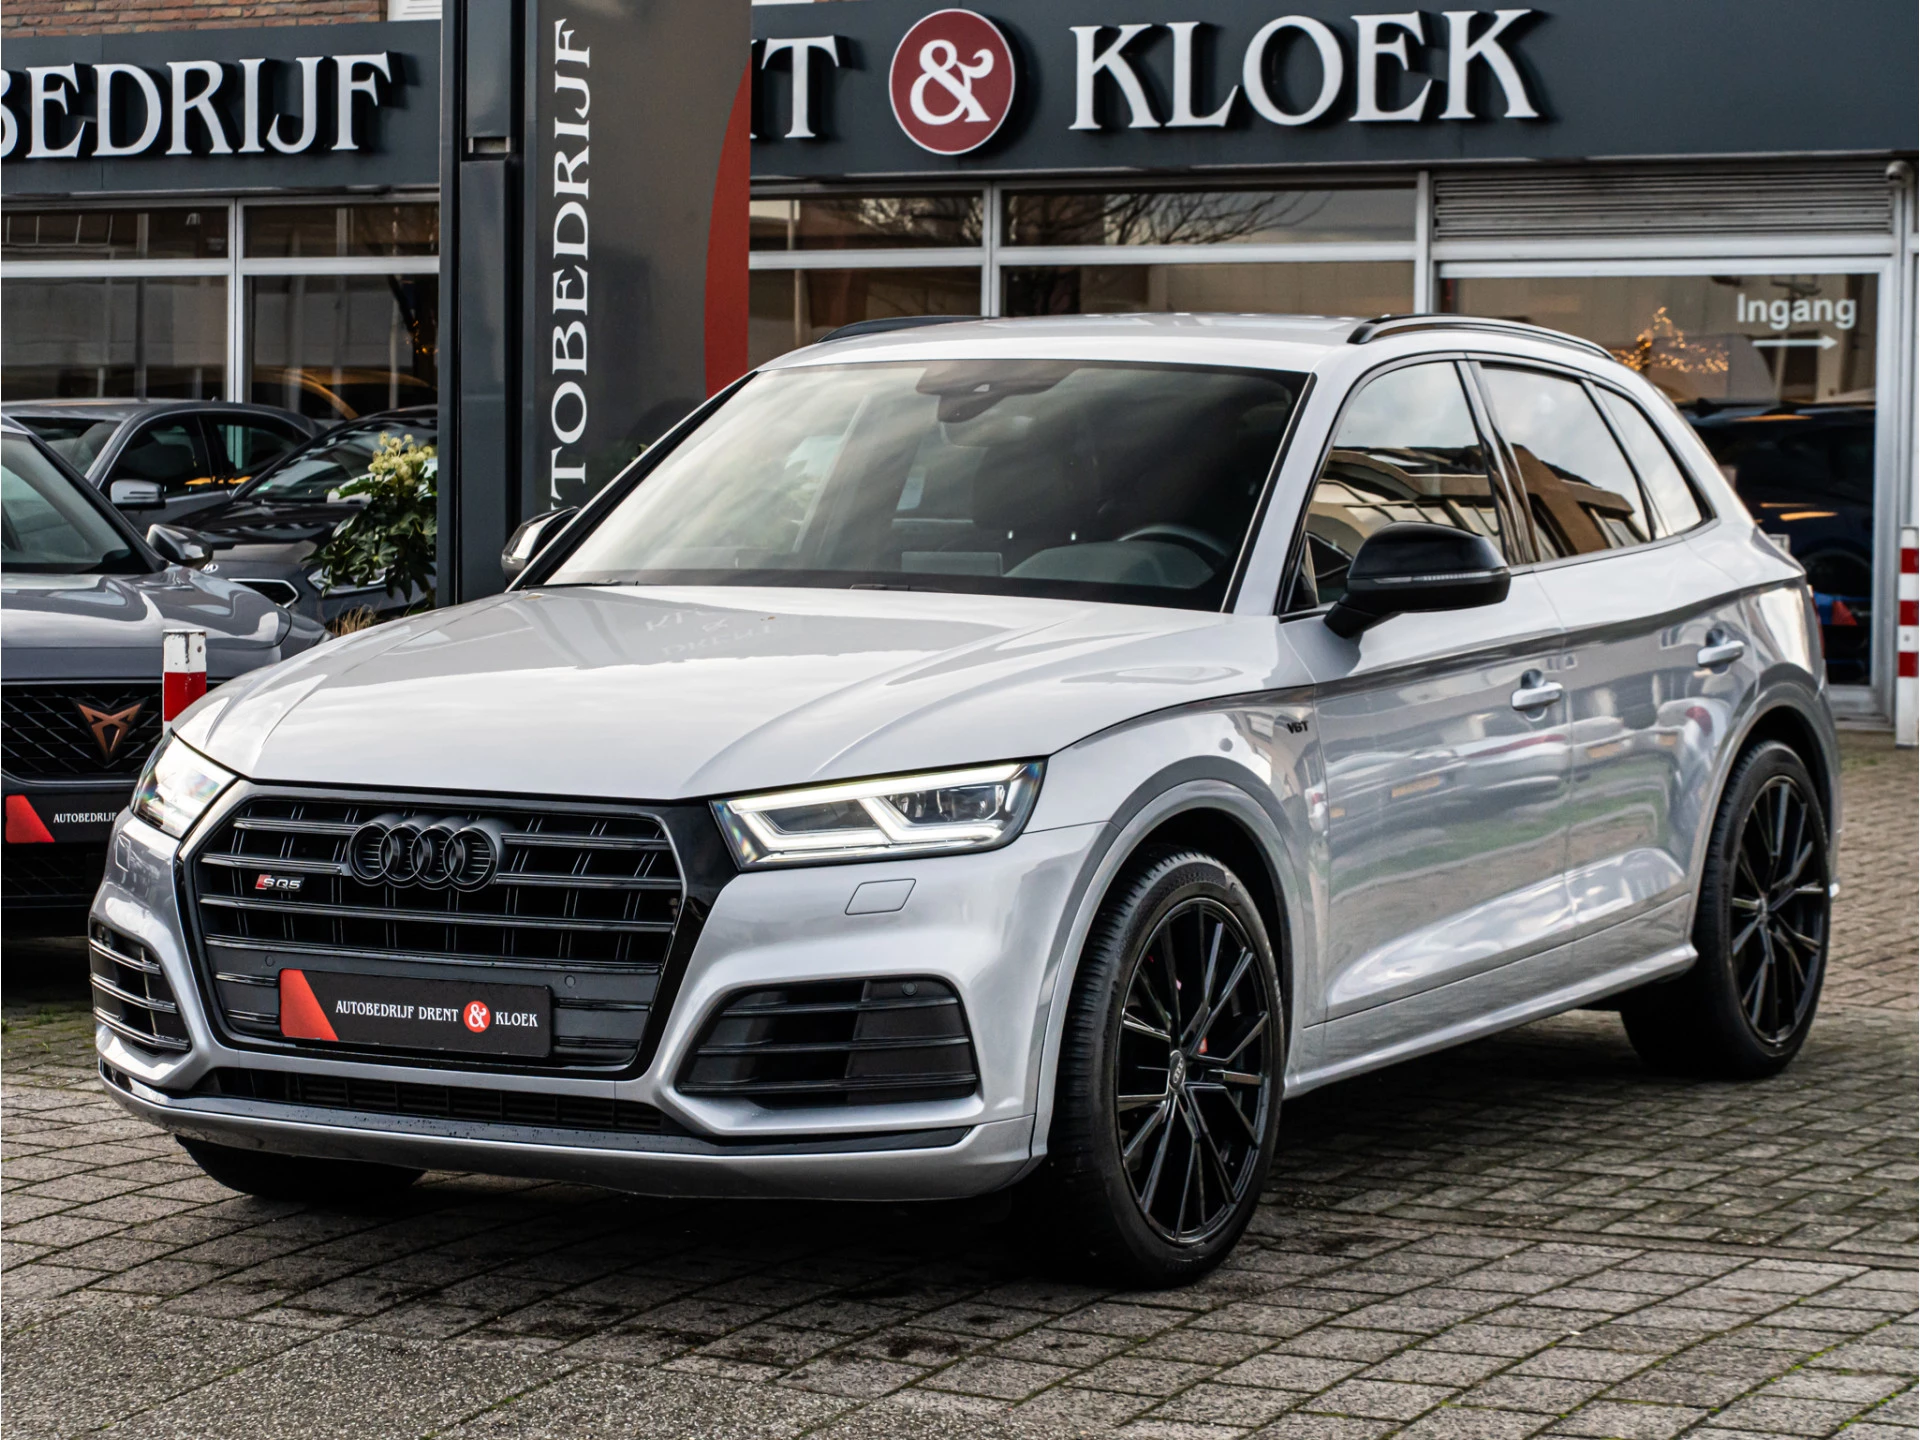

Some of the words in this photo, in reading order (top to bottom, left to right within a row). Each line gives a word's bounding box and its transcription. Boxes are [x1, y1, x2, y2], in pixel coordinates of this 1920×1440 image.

[910, 39, 995, 126] &
[1069, 9, 1539, 130] KLOEK
[551, 18, 591, 511] TOBEDRIJF
[1737, 293, 1856, 330] Ingang
[53, 812, 117, 824] AUTOBEDRIJF
[262, 877, 302, 890] SQ5
[335, 1000, 415, 1019] AUTOBEDRIJF
[418, 1006, 459, 1022] DRENT
[468, 1003, 487, 1028] &
[495, 1011, 538, 1028] KLOEK
